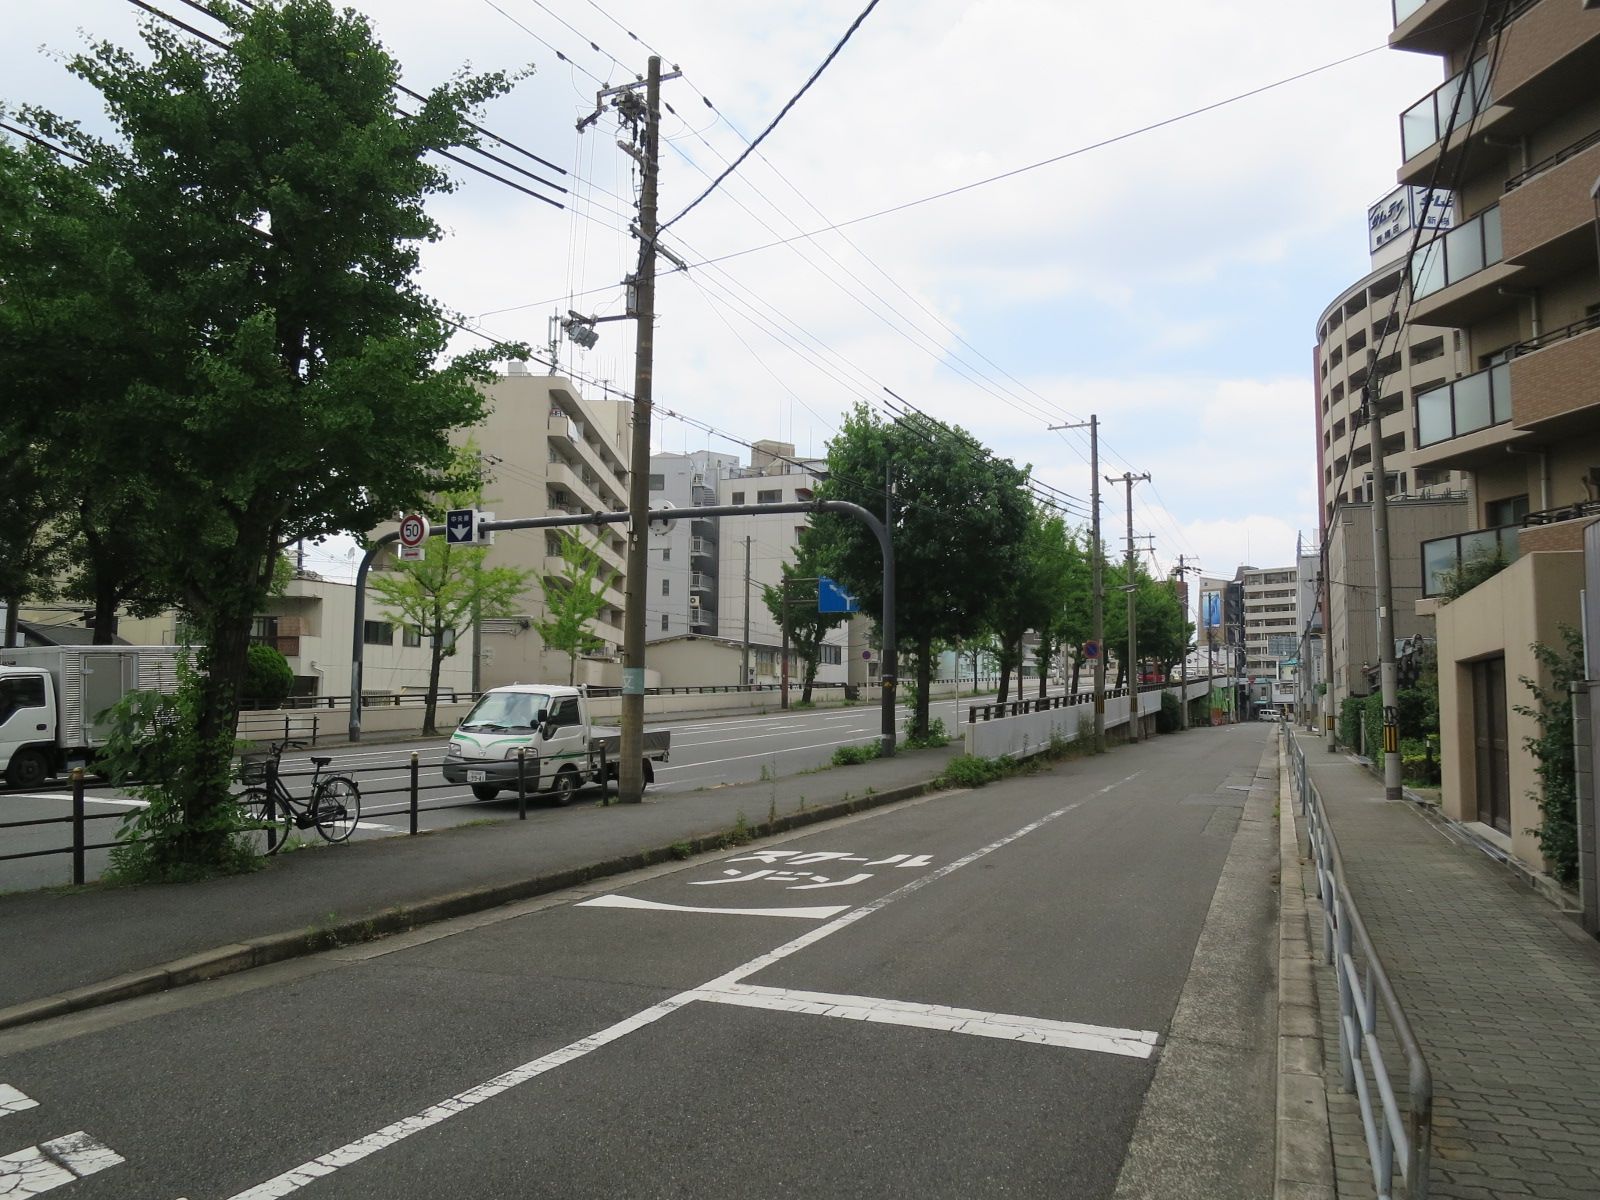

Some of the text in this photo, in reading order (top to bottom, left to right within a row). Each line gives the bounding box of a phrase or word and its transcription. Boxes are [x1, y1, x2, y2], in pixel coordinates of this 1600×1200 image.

[405, 524, 419, 538] 50
[725, 850, 934, 868] スクール
[687, 869, 875, 890] ゾーン
